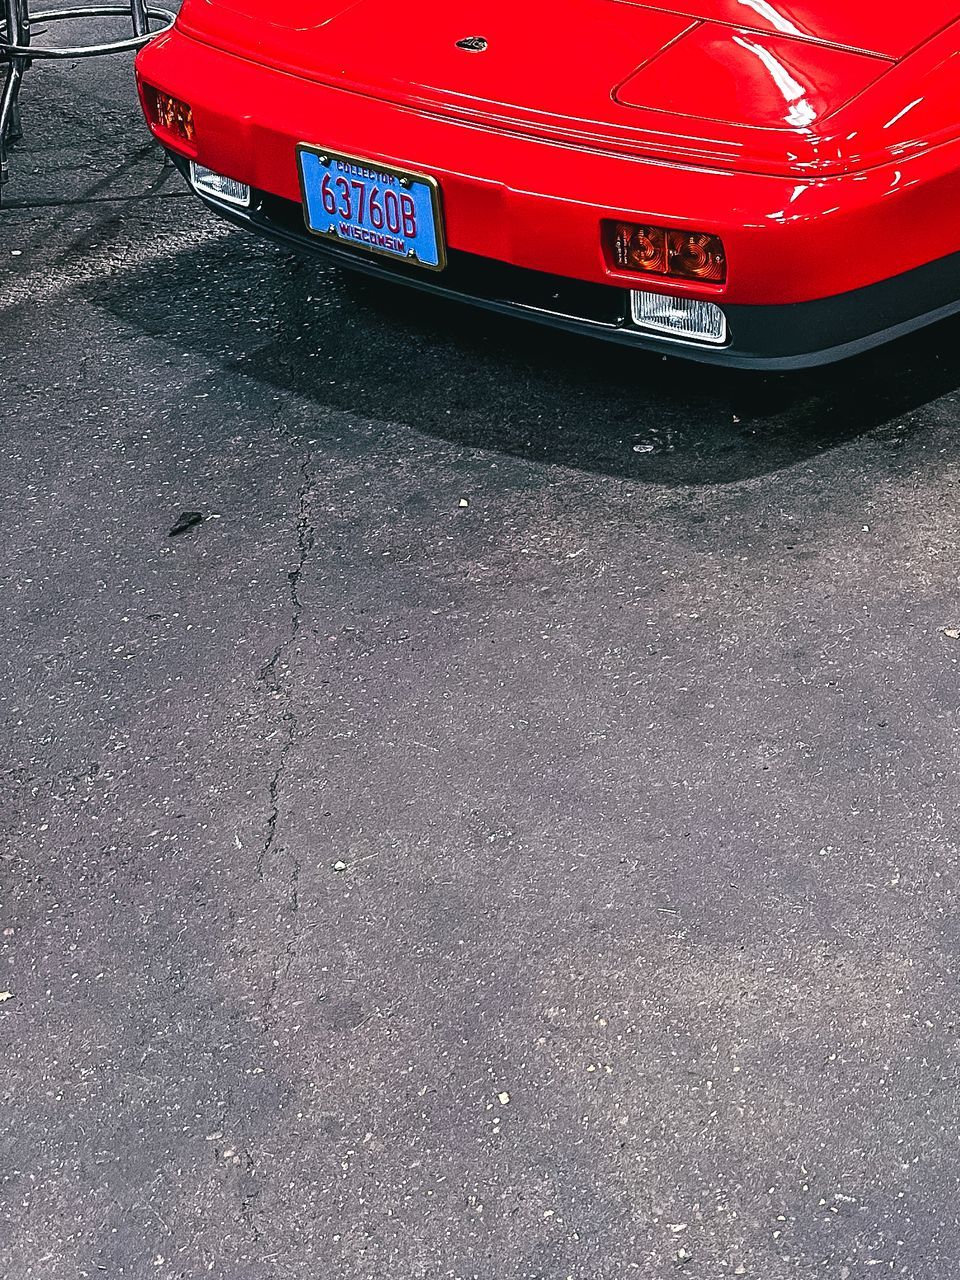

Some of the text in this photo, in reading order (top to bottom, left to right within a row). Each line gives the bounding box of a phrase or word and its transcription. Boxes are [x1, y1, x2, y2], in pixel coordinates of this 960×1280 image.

[336, 160, 395, 187] COLLECTOR
[321, 171, 417, 239] 63760B
[338, 221, 405, 252] WISCONSIN
